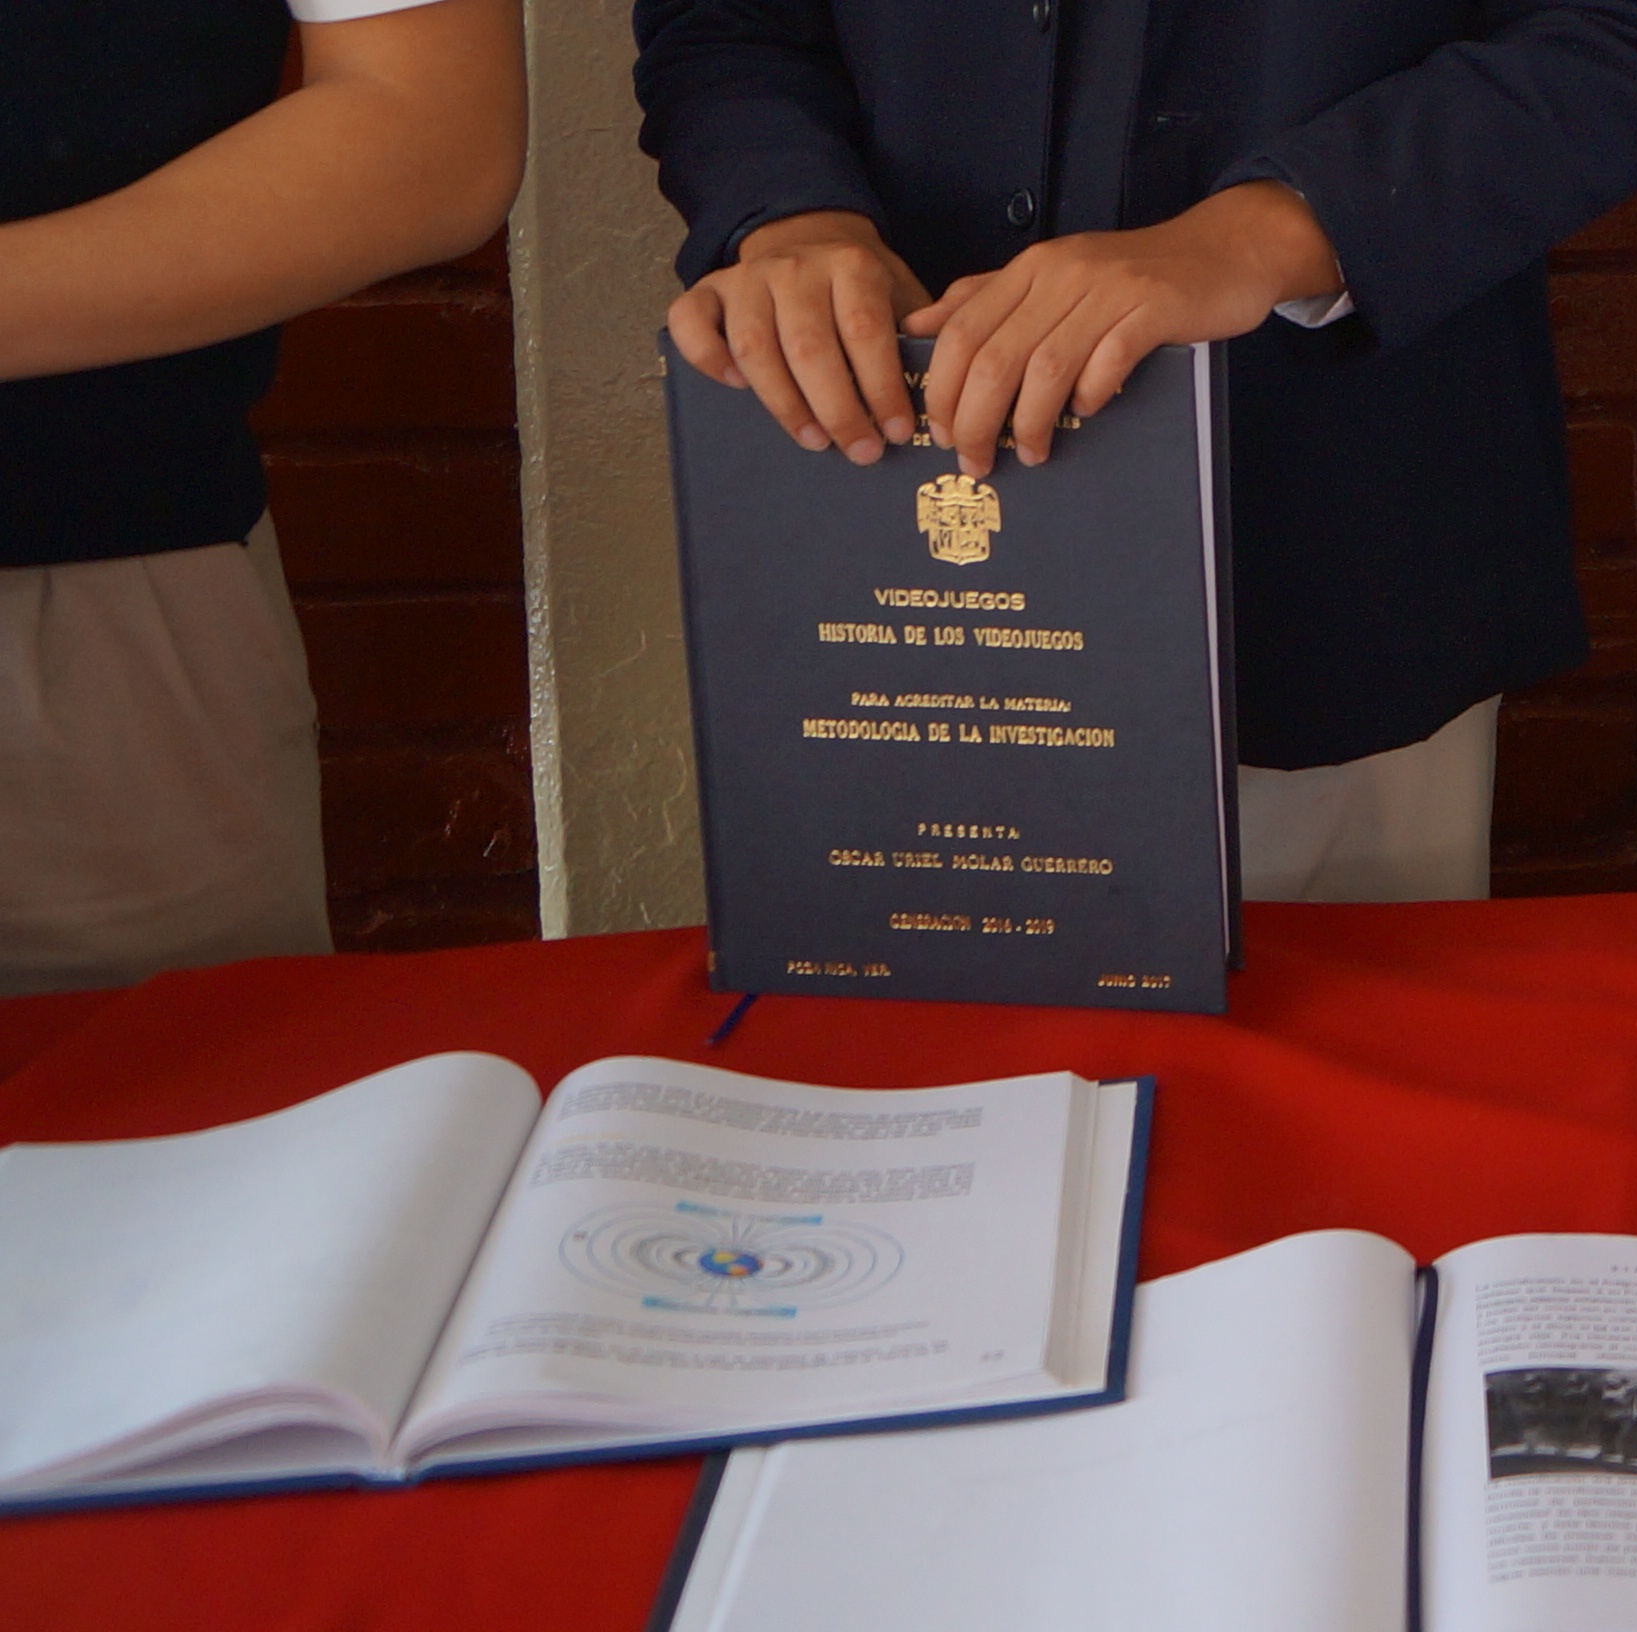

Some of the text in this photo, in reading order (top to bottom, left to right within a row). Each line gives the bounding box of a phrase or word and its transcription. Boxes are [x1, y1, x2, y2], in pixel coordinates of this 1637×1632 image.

[874, 588, 1025, 610] VIDEOJUEGOS
[818, 622, 1083, 651] HISTORIA DE LOS VIDEOJUEGOS
[803, 720, 1115, 748] METODOLOGIA DE LA INVESTIGACION
[953, 855, 1014, 871] MOLAR
[1021, 856, 1113, 875] GUERRERO
